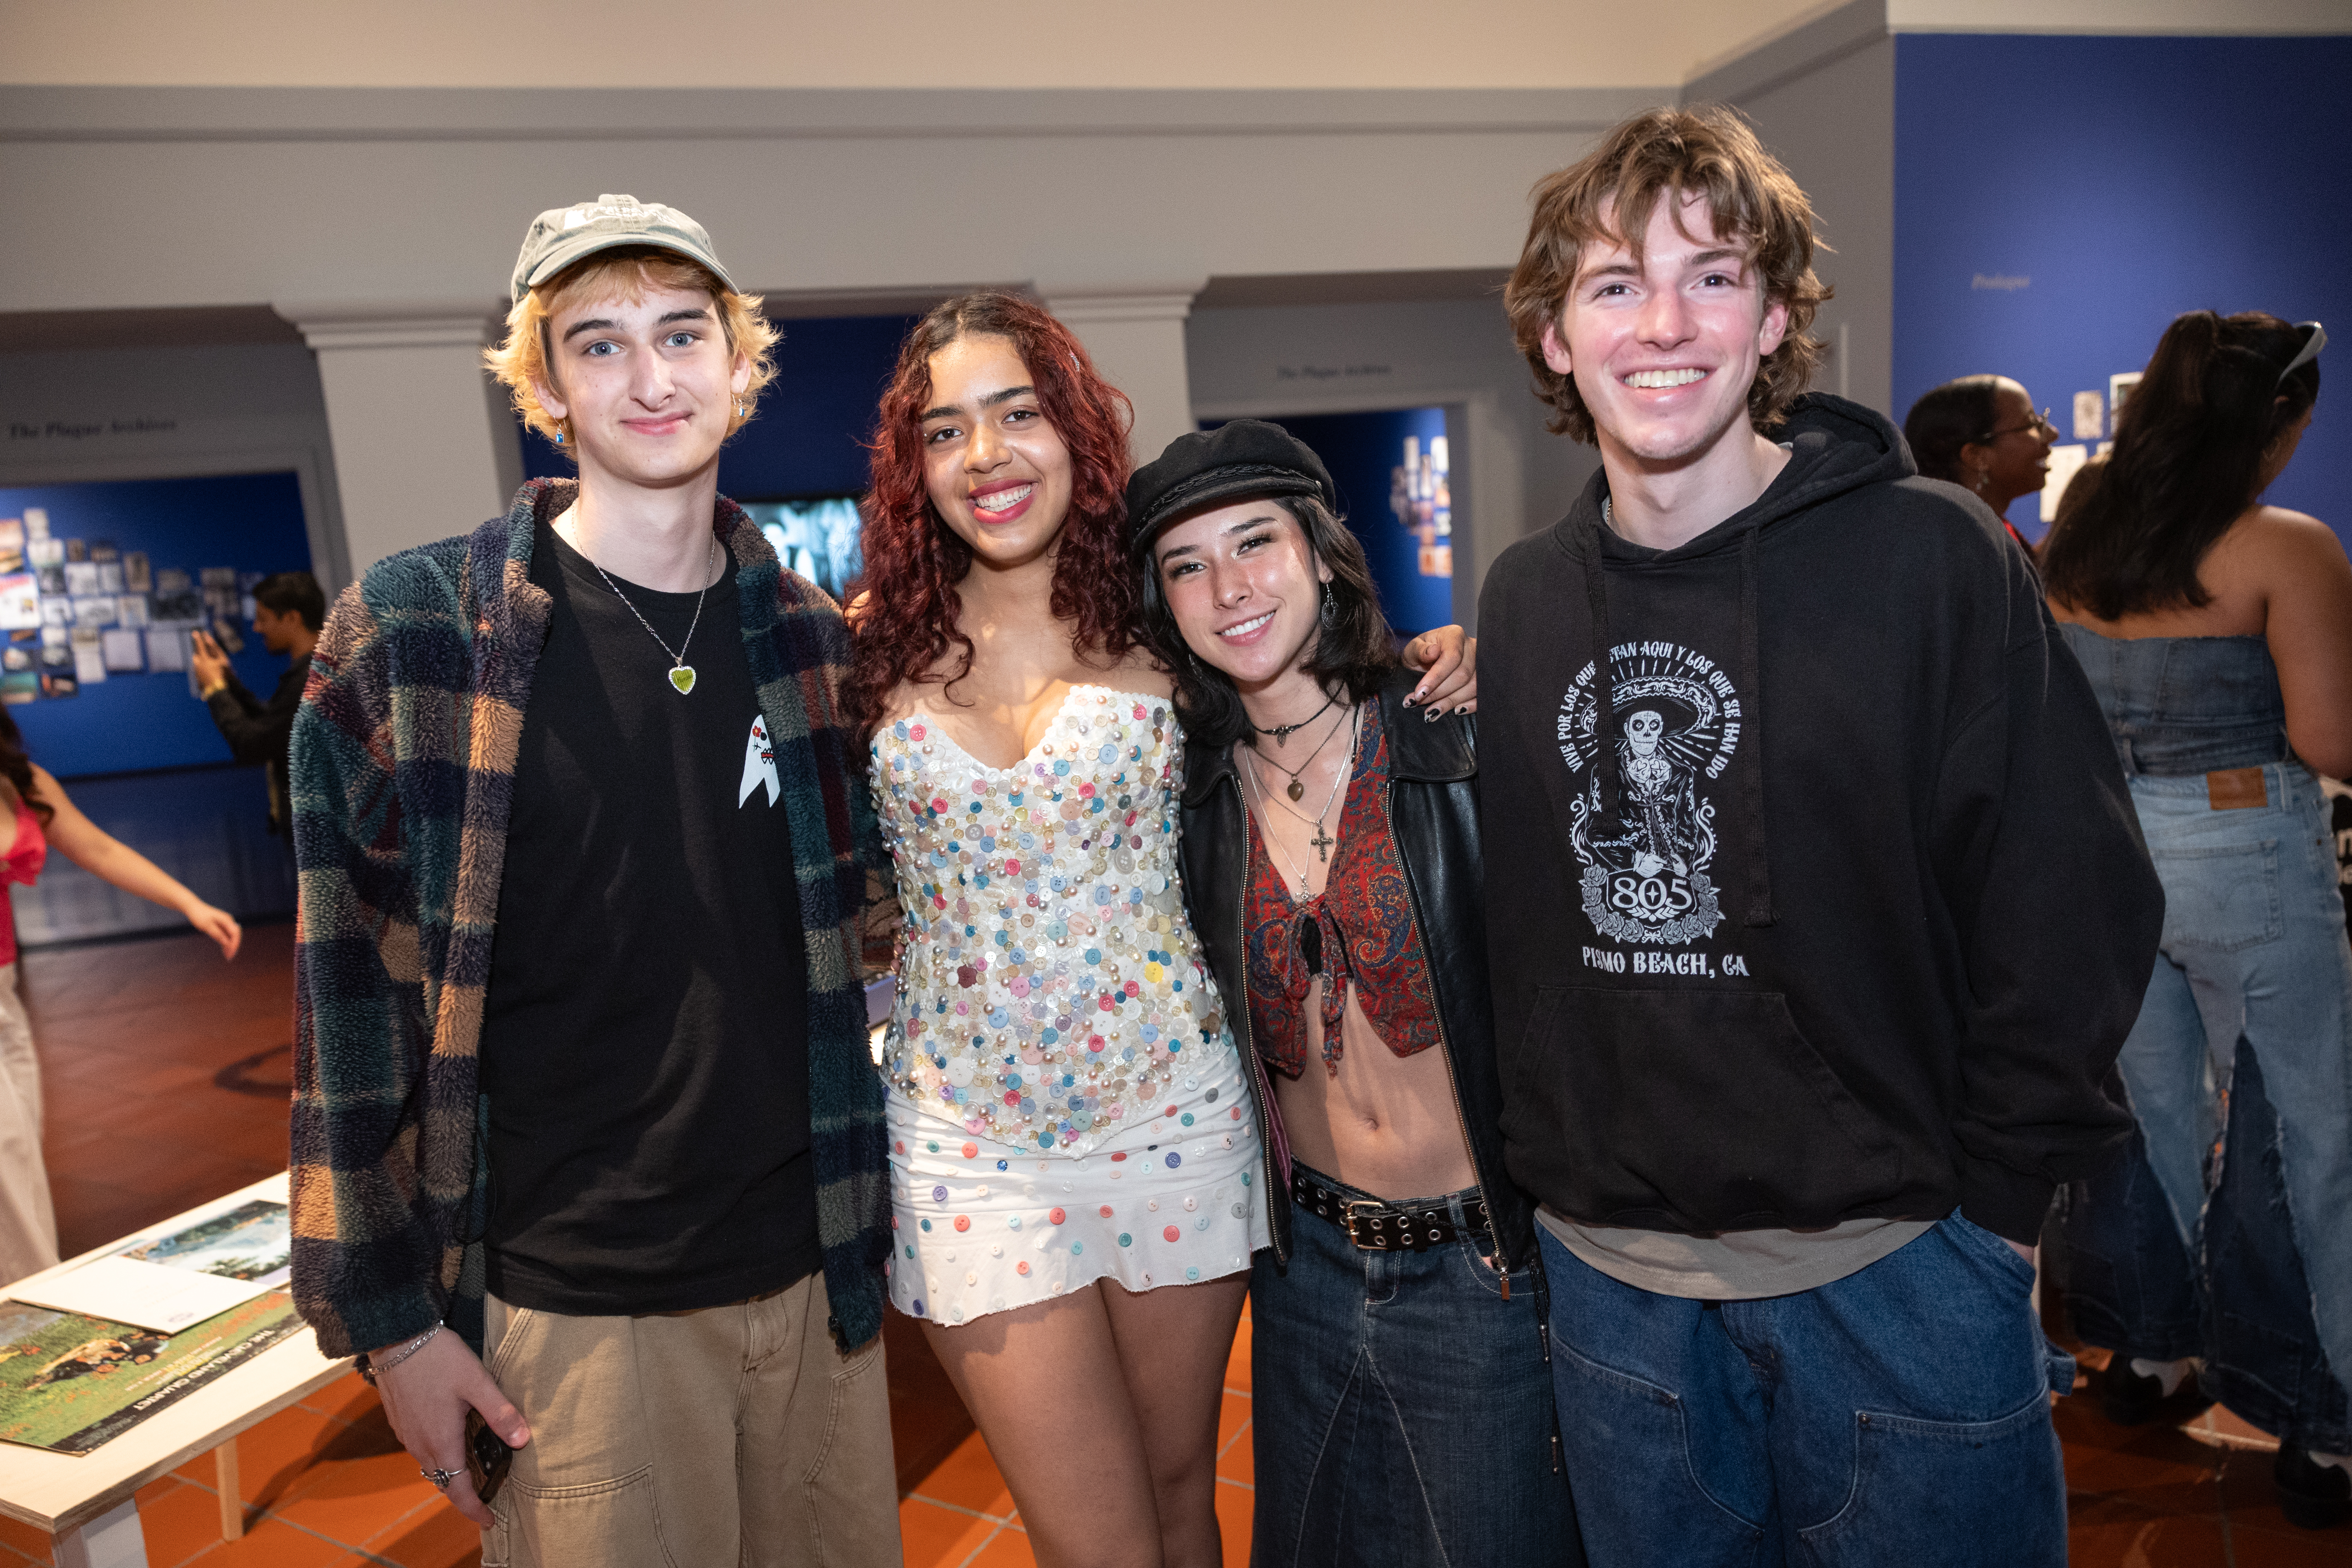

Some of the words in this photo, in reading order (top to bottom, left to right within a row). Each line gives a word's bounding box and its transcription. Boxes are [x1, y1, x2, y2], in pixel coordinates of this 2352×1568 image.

[1640, 641, 1674, 658] AQUI
[1675, 645, 1687, 661] Y
[1684, 650, 1715, 674] LOS
[1575, 660, 1596, 686] QUE
[1709, 671, 1736, 698] QUE
[1560, 684, 1580, 712] LOS
[1723, 699, 1742, 718] SE
[1558, 714, 1573, 740] POR
[1719, 722, 1741, 755] HAN
[1559, 743, 1584, 773] VIVE
[1706, 754, 1729, 779] IDO
[1612, 877, 1692, 909] 805
[1582, 946, 1626, 973] PISMO
[1633, 951, 1715, 979] BEACH,
[1722, 953, 1750, 976] CA
[188, 1342, 252, 1379] CLEVELAND
[132, 1378, 191, 1411] QUARTET
